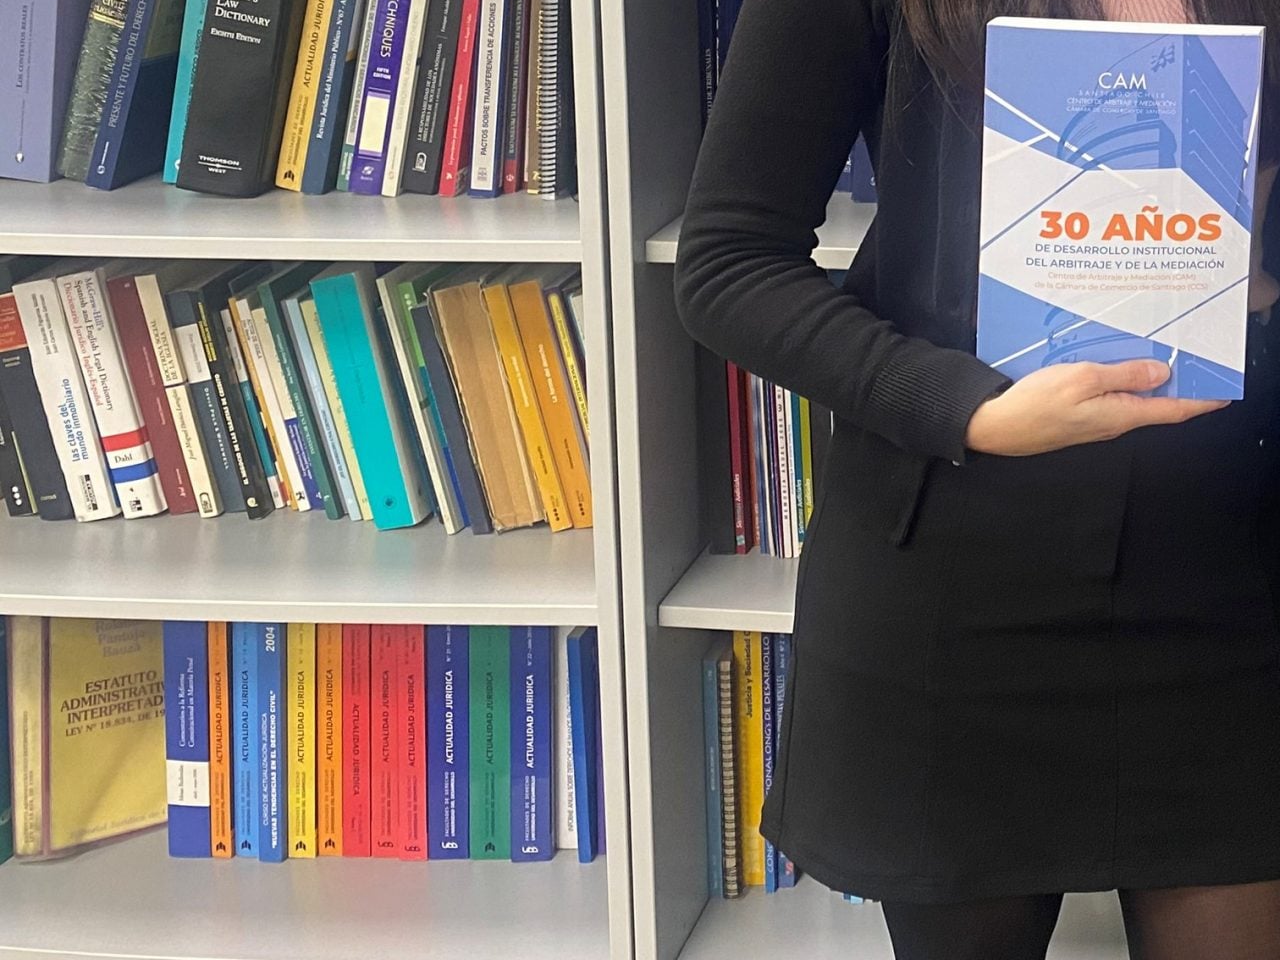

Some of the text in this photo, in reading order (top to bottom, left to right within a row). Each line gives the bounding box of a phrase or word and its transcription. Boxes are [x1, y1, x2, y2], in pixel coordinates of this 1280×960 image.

[1099, 72, 1147, 89] CAM
[1039, 206, 1222, 241] 30 AÑOS
[1035, 244, 1216, 255] DE DESARROLLO INSTITUCIONAL
[1026, 257, 1224, 269] DEL ARBITRAJE Y DE LA MEDIACIÓN
[60, 377, 89, 460] mundo inmobiliario
[58, 403, 80, 462] las claves del
[114, 453, 132, 462] Dahl
[265, 626, 274, 651] 2004
[84, 670, 157, 693] ESTATUTO
[445, 711, 453, 763] ACTUALIDAD
